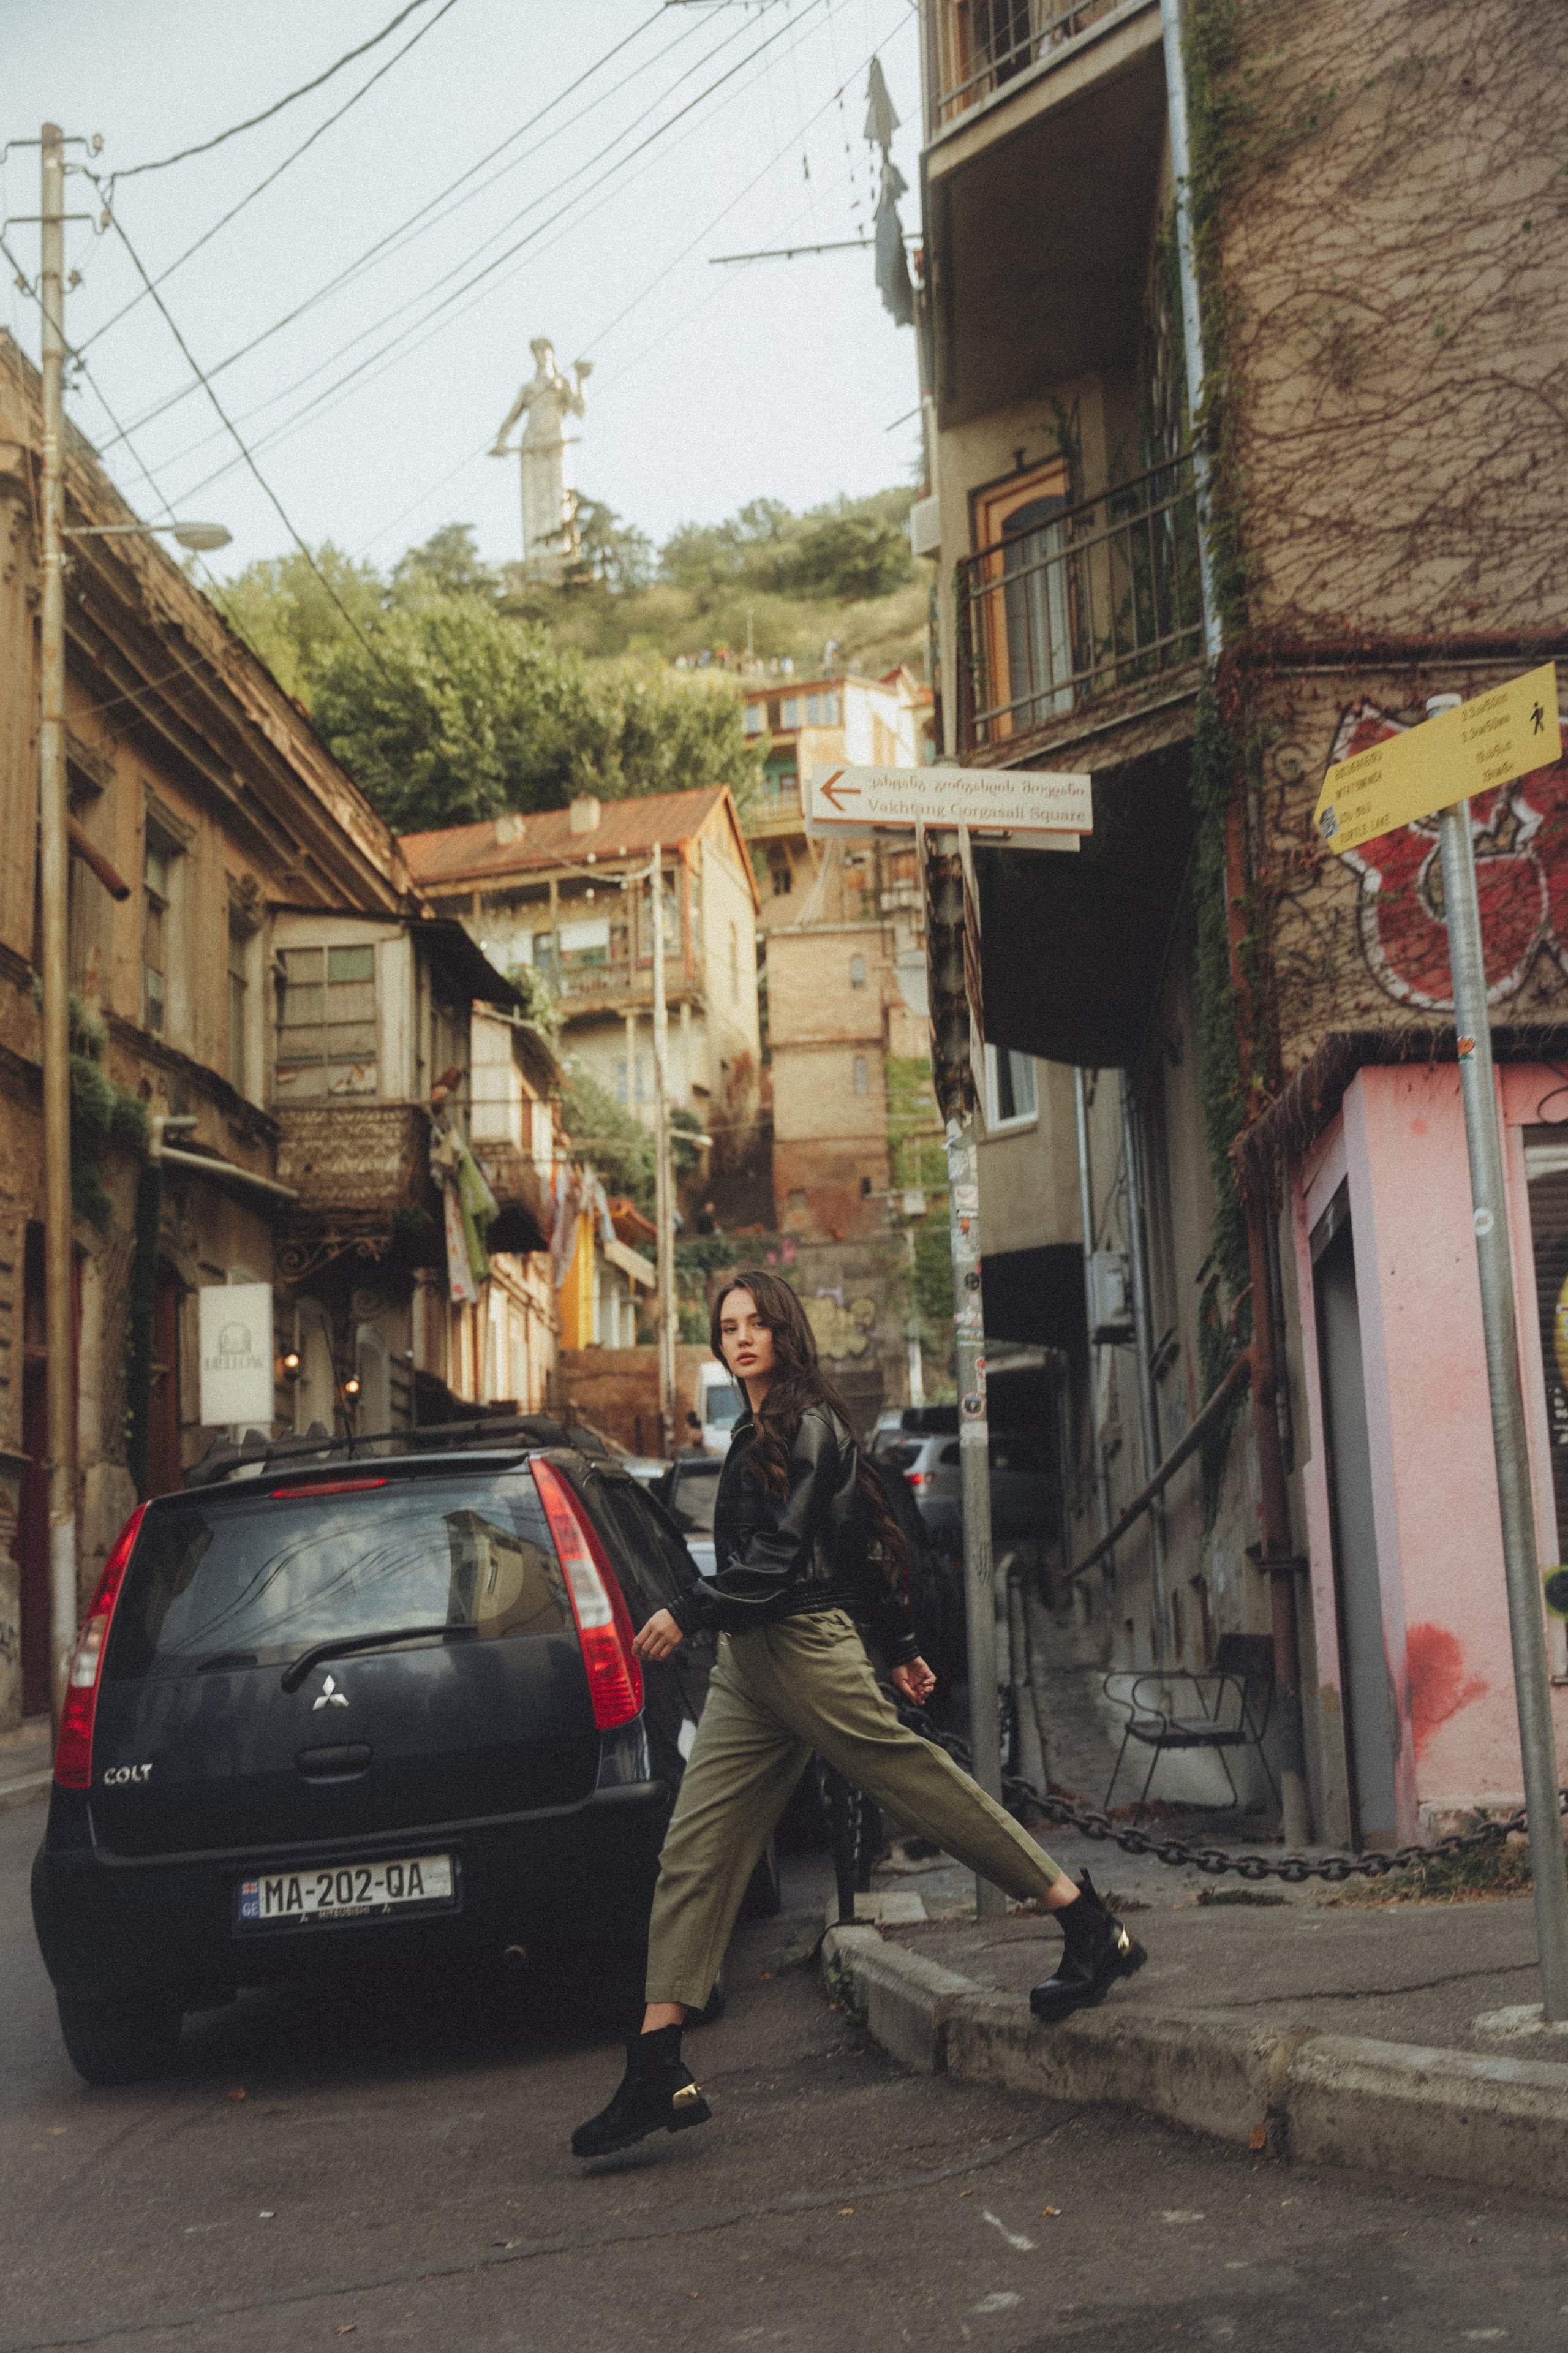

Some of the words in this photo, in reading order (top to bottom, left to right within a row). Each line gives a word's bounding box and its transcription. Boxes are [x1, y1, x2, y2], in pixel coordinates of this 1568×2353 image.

[868, 799, 945, 818] Vakhtang
[950, 802, 1024, 821] Gorgasali
[1030, 807, 1085, 825] Square
[104, 1763, 153, 1786] COLT
[264, 1862, 424, 1914] MA-202-QA
